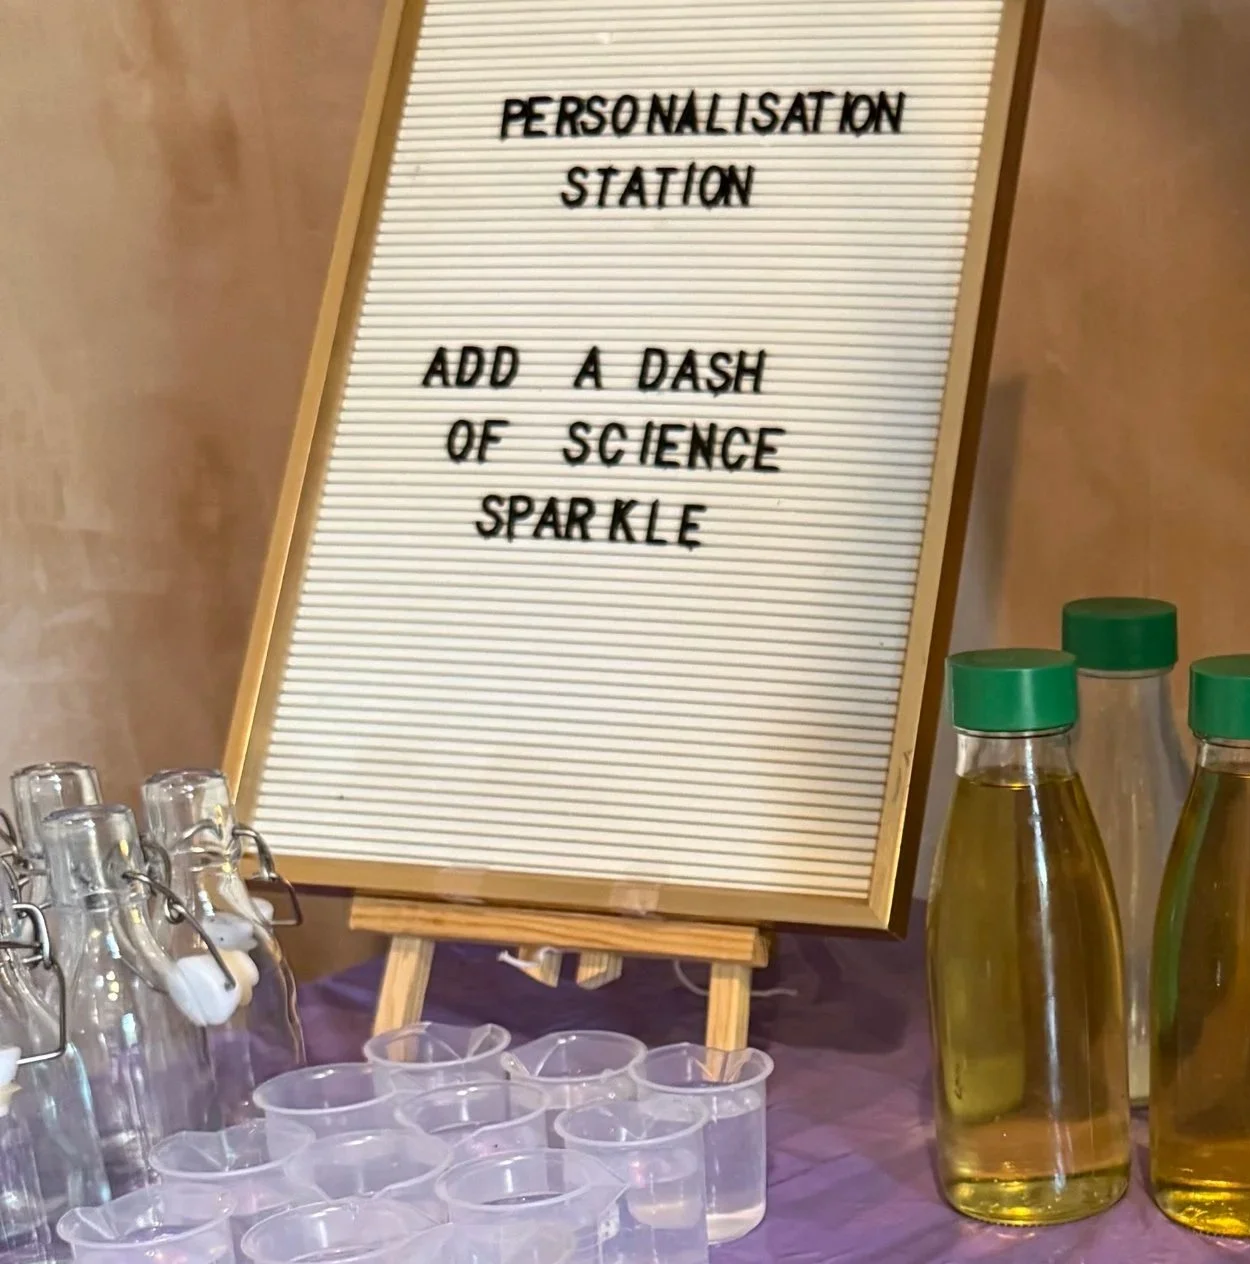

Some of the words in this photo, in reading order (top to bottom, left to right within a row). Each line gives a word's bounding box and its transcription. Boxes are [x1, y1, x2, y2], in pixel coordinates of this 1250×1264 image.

[500, 89, 905, 139] PERSONALISATION
[560, 162, 756, 209] STATION
[423, 344, 518, 389] ADD
[574, 346, 604, 389] A
[638, 347, 767, 397] DASH
[446, 419, 510, 464] OF
[562, 420, 786, 473] SCIENCE
[476, 494, 706, 548] SPARKLE
